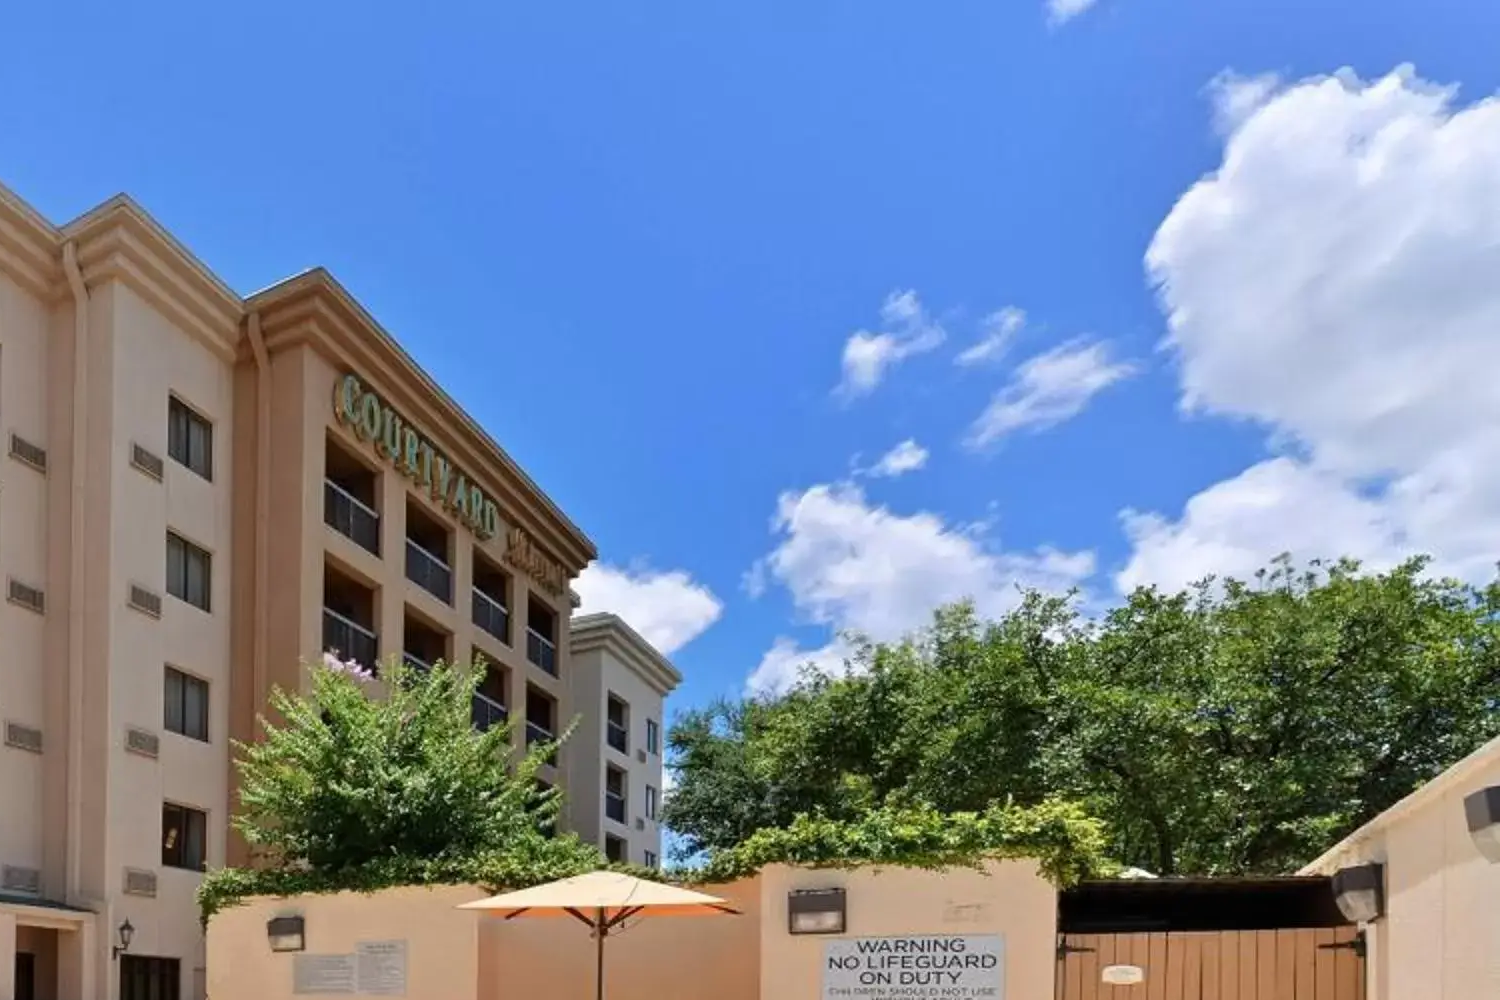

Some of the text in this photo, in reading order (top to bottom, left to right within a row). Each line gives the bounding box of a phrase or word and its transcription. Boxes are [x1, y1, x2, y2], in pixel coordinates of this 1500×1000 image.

[336, 375, 499, 540] COURTYARD
[856, 937, 967, 953] WARNING
[828, 953, 997, 971] NO LIFEGUARD
[859, 970, 963, 986] ON DUTY
[828, 986, 997, 997] CHILDREN SHOULD NOT USE
